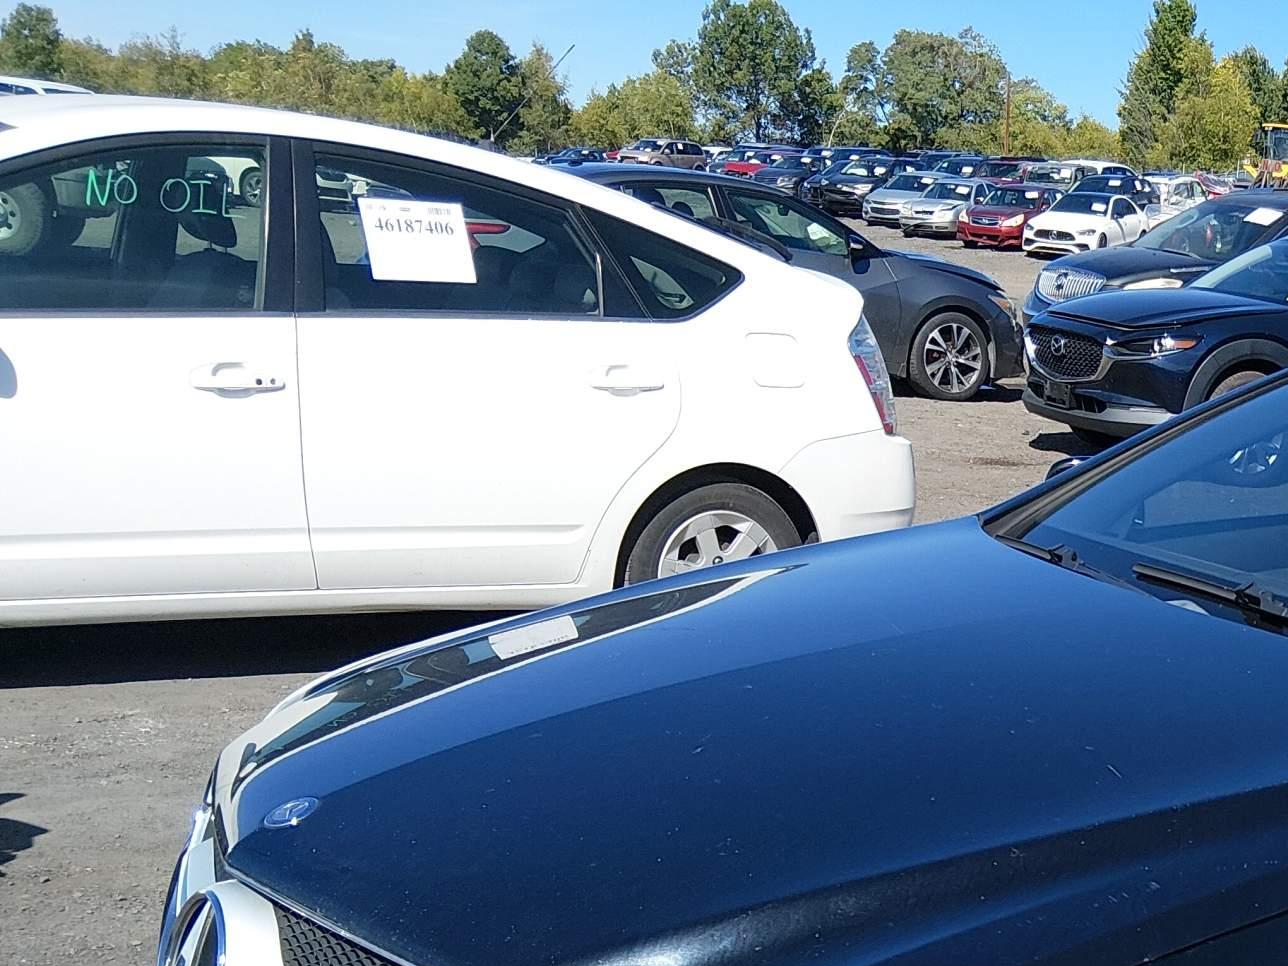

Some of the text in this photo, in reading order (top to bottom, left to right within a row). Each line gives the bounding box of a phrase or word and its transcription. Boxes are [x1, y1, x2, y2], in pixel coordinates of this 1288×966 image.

[86, 168, 246, 218] NO OIL
[374, 217, 455, 236] 46187406
